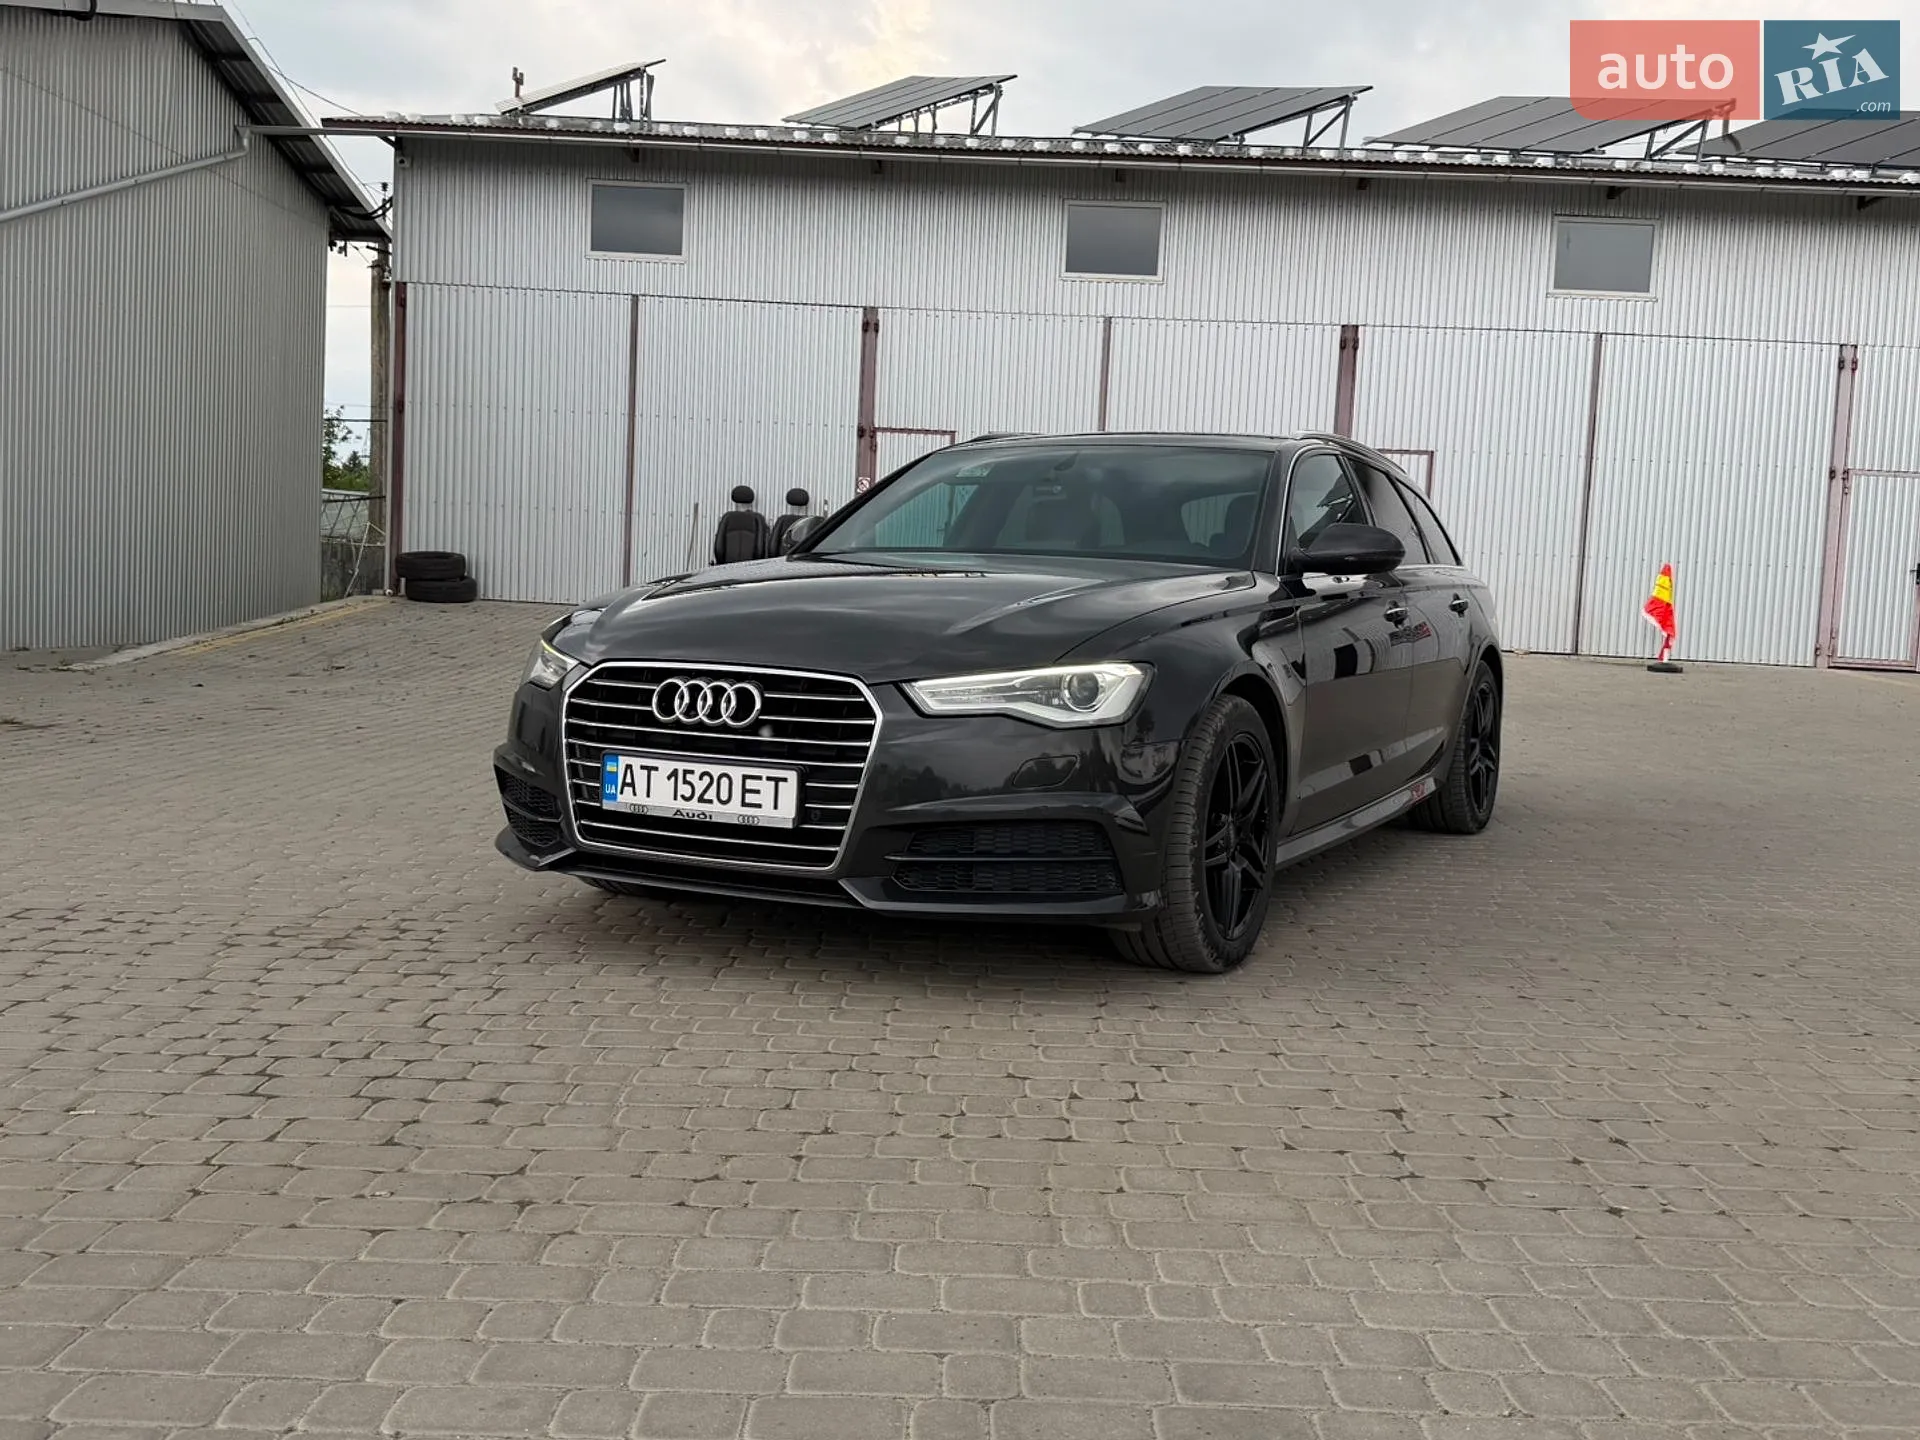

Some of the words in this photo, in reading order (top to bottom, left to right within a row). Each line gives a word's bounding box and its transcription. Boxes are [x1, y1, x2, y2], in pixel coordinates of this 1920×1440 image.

[605, 783, 616, 794] UA
[619, 763, 659, 798] AT
[666, 768, 733, 805] 1520
[741, 774, 788, 810] ET
[672, 809, 713, 820] Audi
